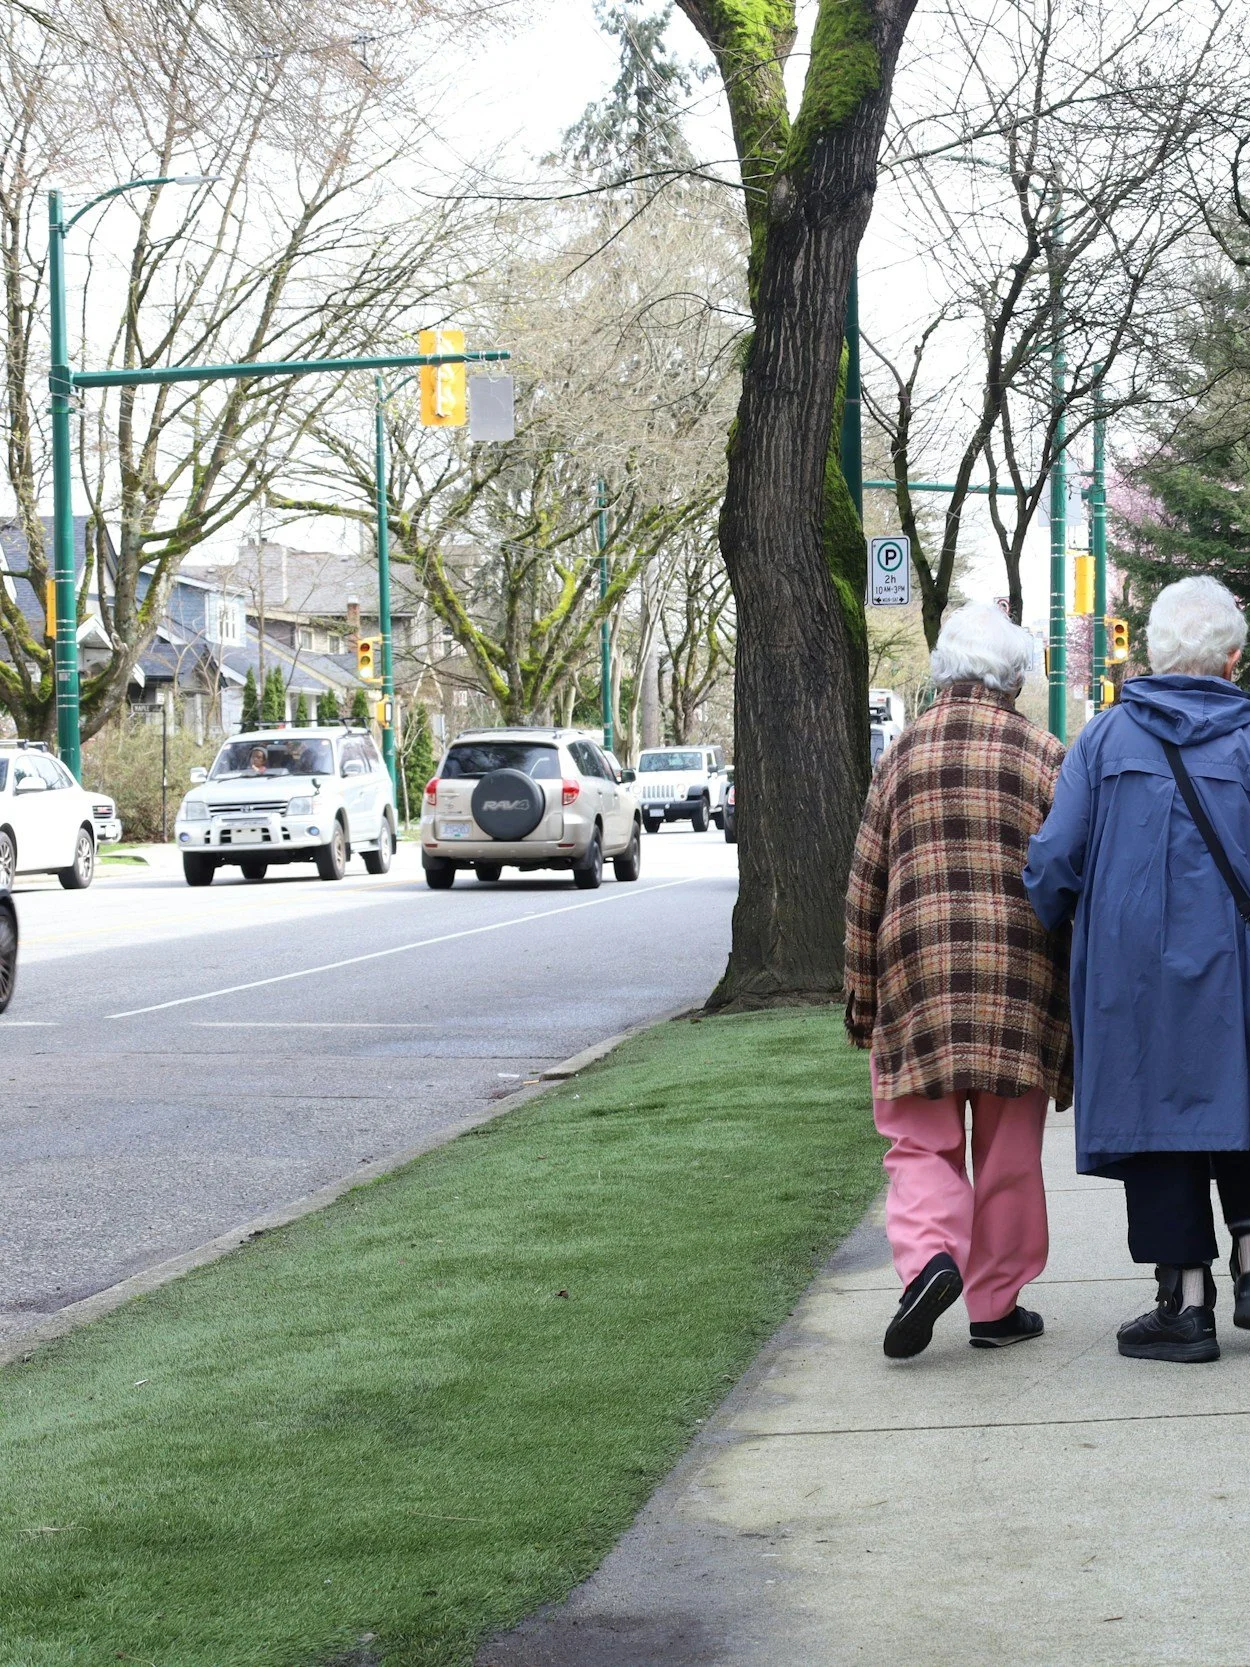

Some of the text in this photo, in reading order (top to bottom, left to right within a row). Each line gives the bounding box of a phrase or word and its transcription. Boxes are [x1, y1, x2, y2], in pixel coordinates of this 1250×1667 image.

[885, 549, 897, 565] P
[885, 575, 896, 584] 2h
[482, 799, 530, 811] RAV4
